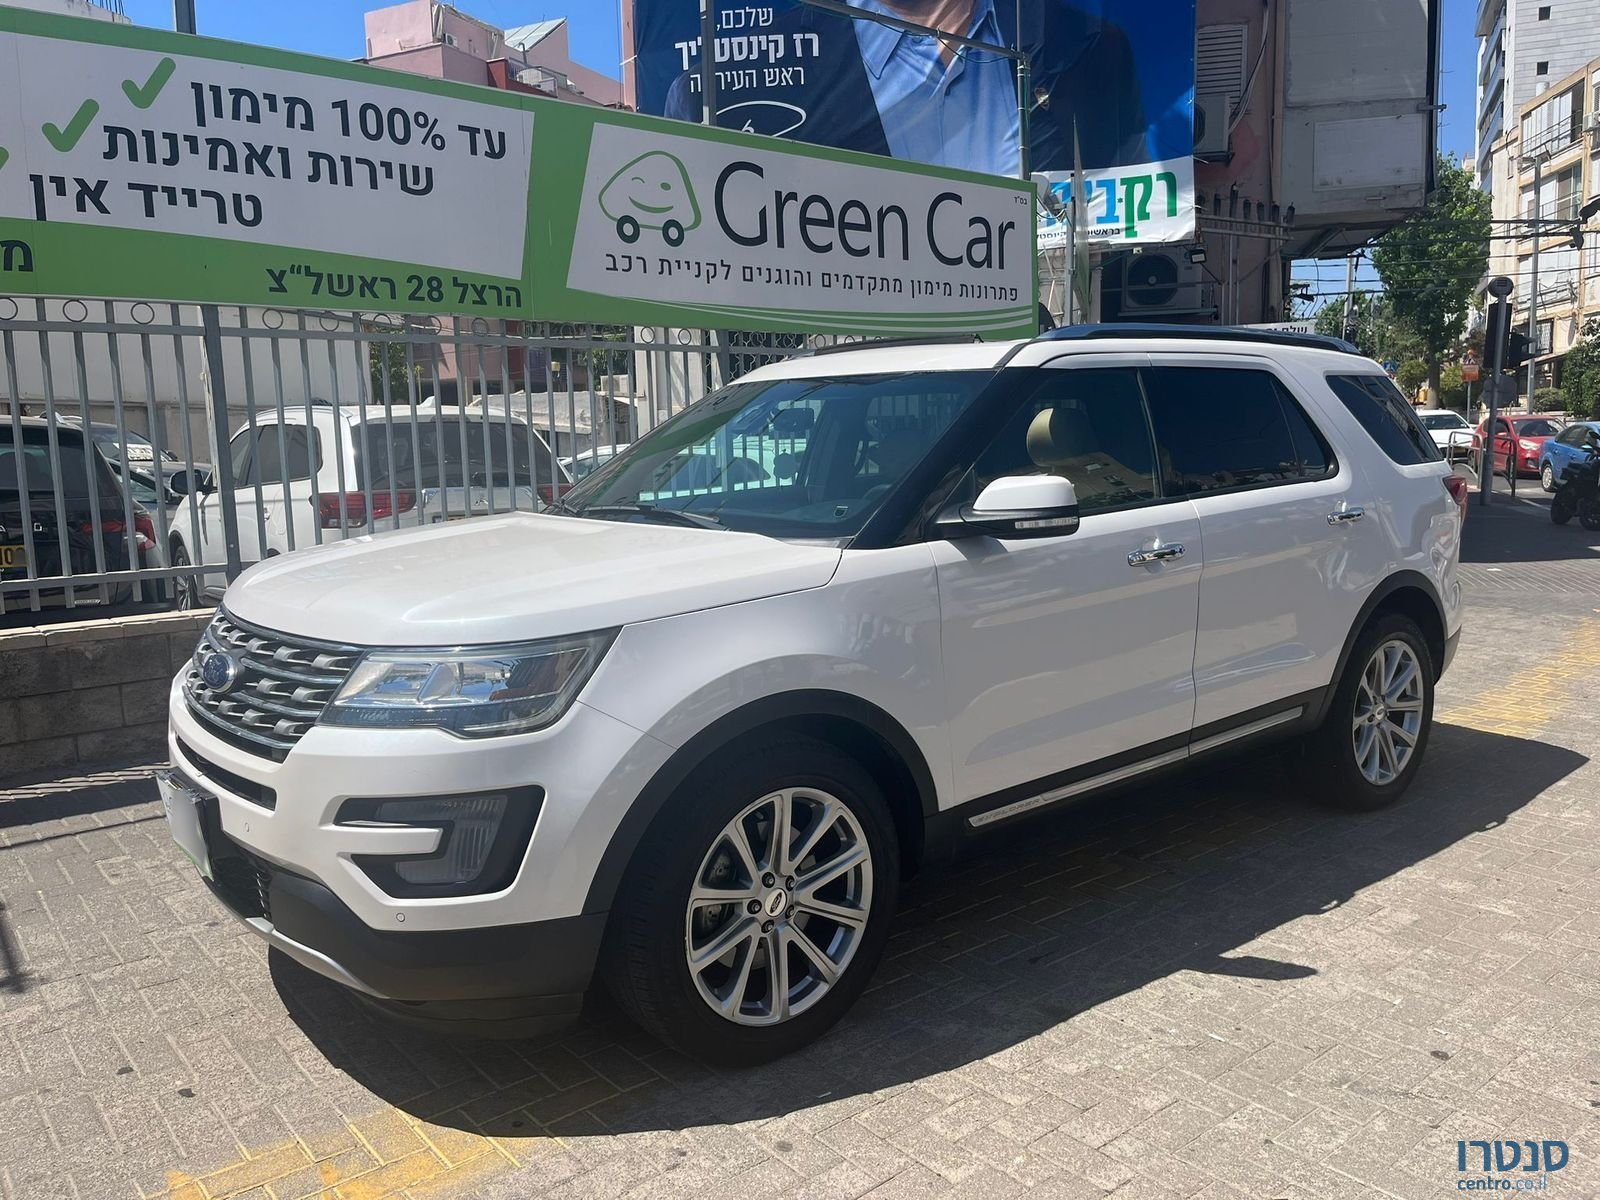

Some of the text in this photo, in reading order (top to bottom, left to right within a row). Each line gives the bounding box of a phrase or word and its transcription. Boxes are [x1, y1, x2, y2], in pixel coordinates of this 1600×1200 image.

[716, 6, 773, 31] שלכם,
[793, 32, 819, 57] רז
[763, 66, 804, 87] ראש
[191, 82, 506, 159] עד 100% מימון
[103, 125, 434, 196] שירות ואמינות
[29, 174, 263, 227] טרייד אין
[715, 161, 1015, 270] Green Car
[1120, 171, 1177, 238] רק
[407, 275, 444, 303] 28
[453, 277, 522, 308] הרצל
[606, 254, 1018, 301] פתרונות מימון מתקדמים והוגנים לקניית רכב
